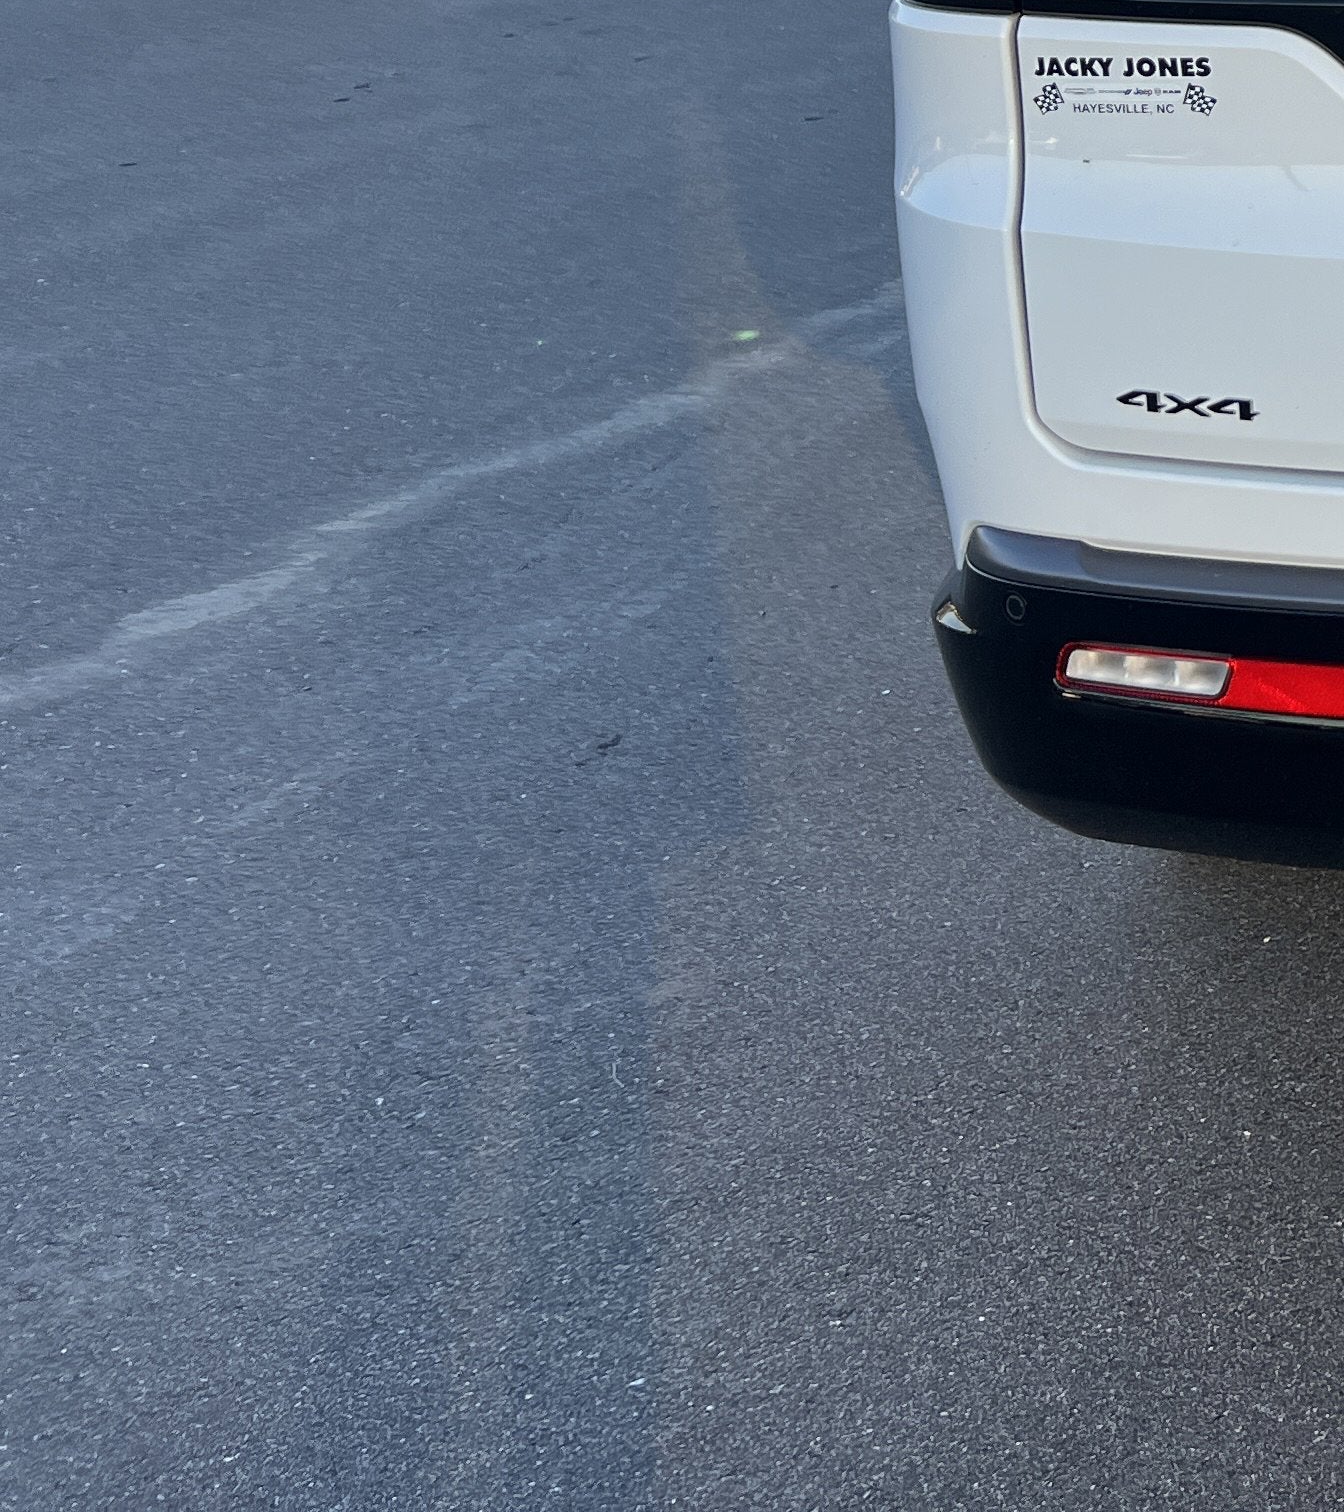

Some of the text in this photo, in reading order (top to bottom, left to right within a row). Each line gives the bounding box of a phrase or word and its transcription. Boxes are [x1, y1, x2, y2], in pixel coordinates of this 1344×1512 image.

[1034, 56, 1212, 77] JACKY JONES
[1073, 103, 1175, 115] HAYESVILLE, NC
